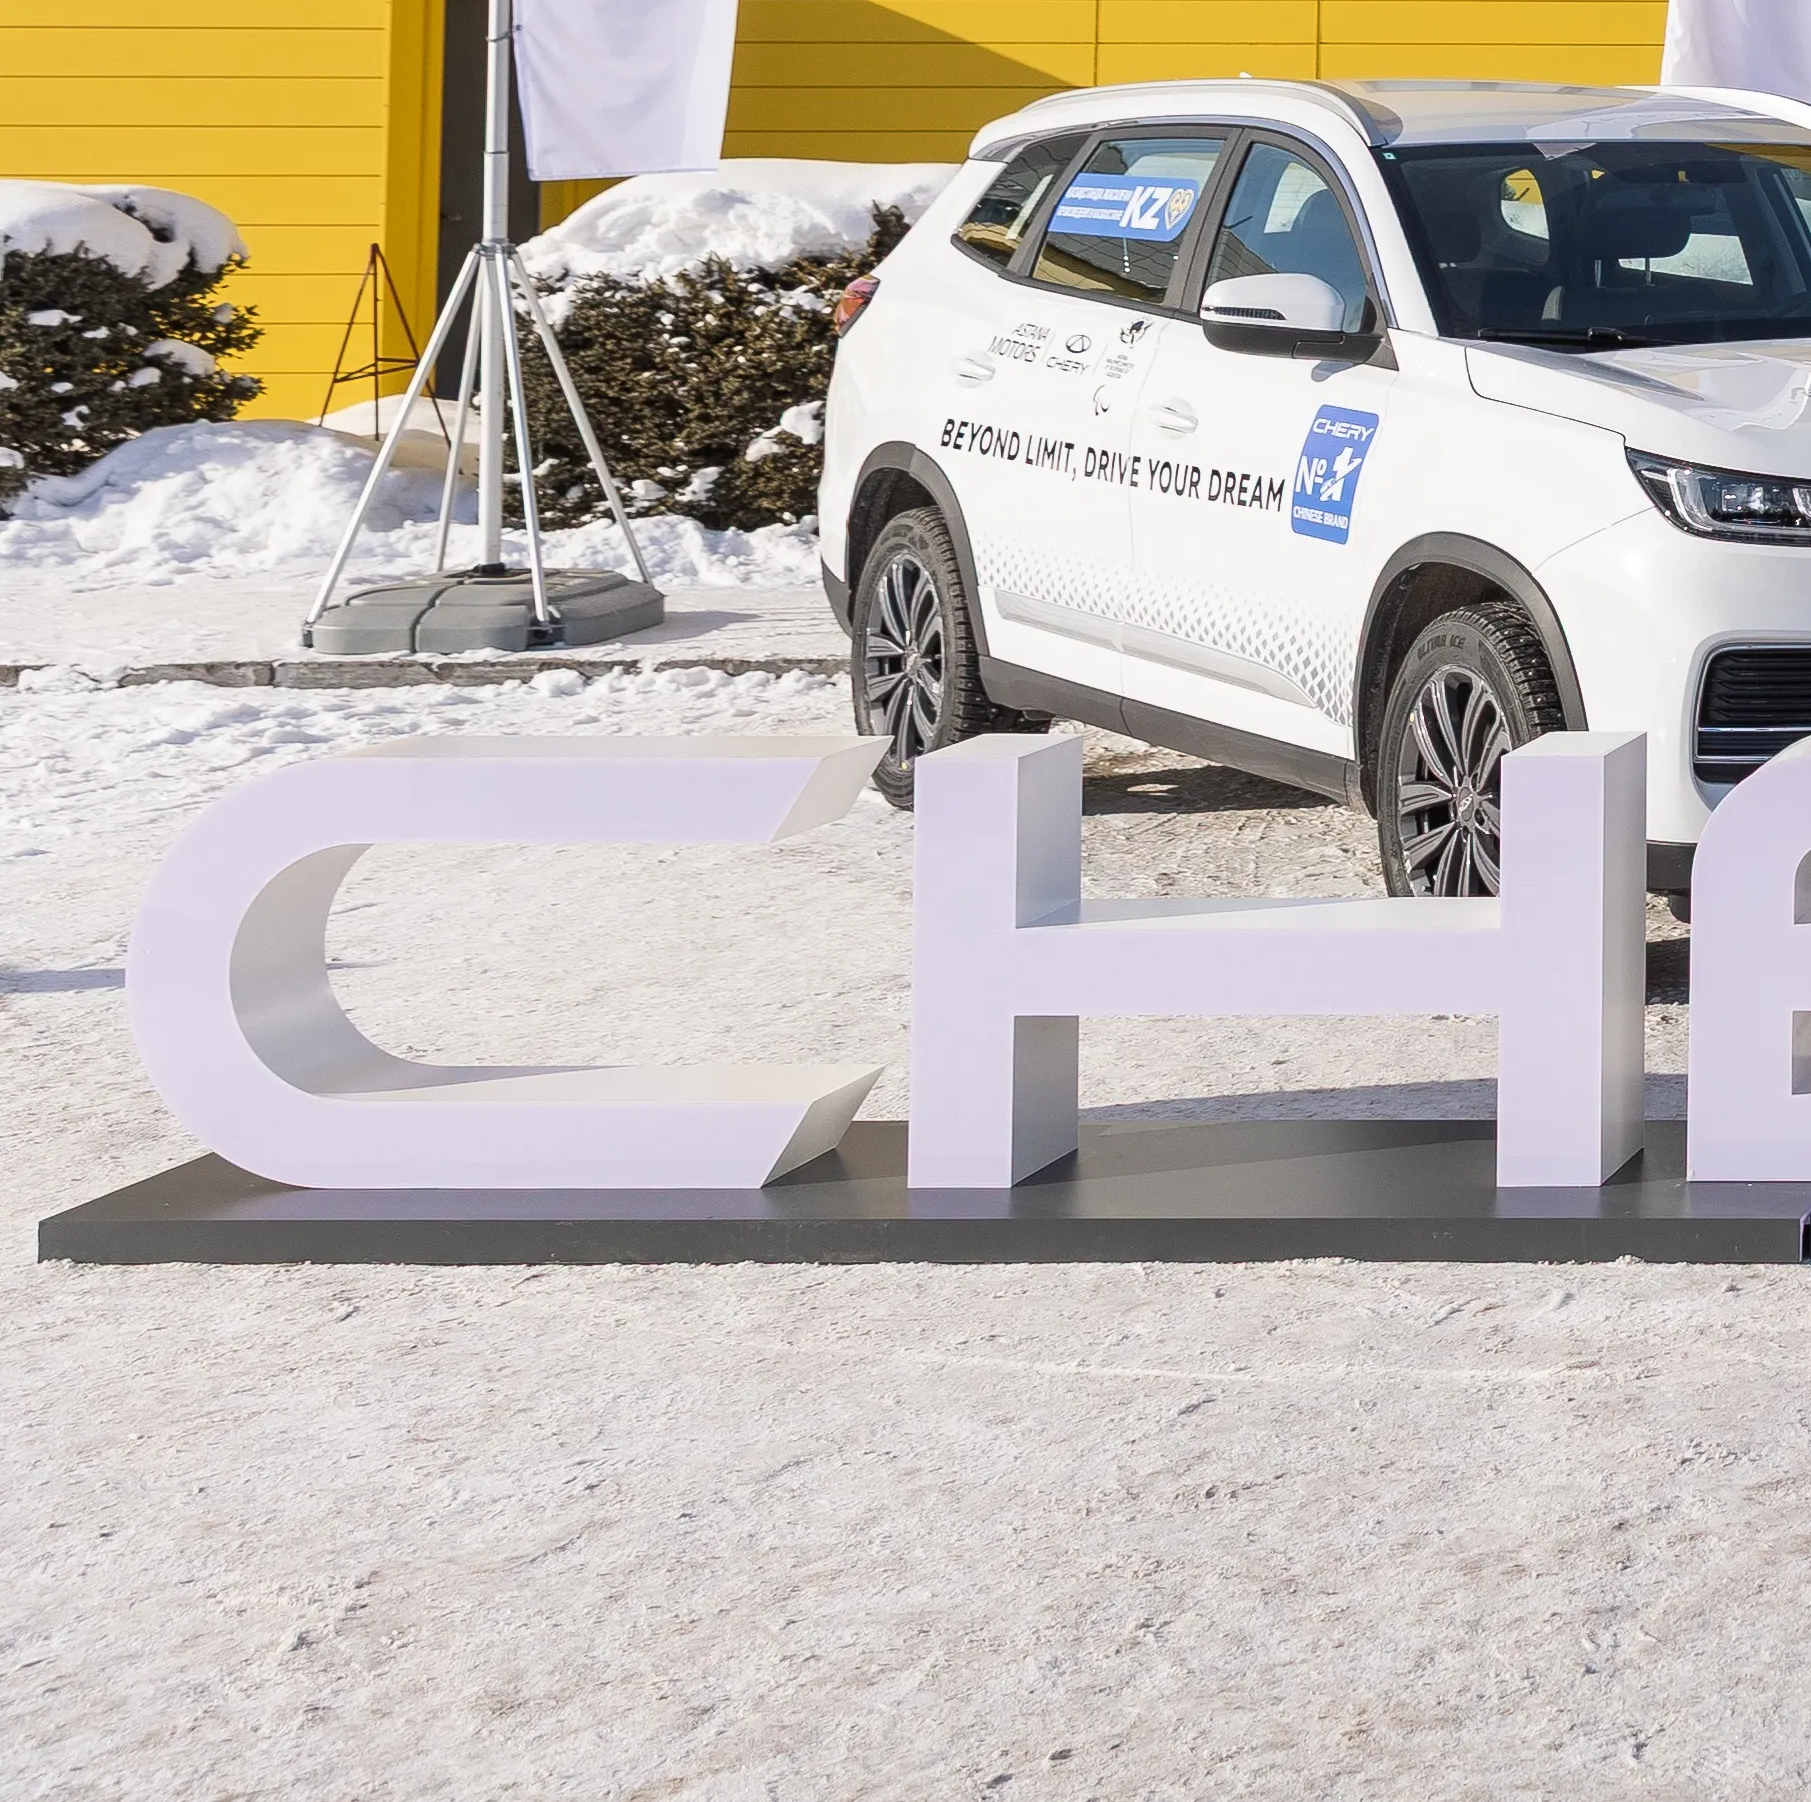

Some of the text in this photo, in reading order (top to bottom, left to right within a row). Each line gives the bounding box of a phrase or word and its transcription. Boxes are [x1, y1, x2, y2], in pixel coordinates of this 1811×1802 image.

[1119, 185, 1174, 230] KZ
[988, 335, 1043, 364] MOTORS
[1046, 355, 1090, 376] CHERY
[1312, 417, 1375, 442] CHERY
[940, 418, 1286, 512] BEYOND LIMIT, DRIVE YOUR DREAM
[1292, 505, 1349, 530] CHINESE BRAND
